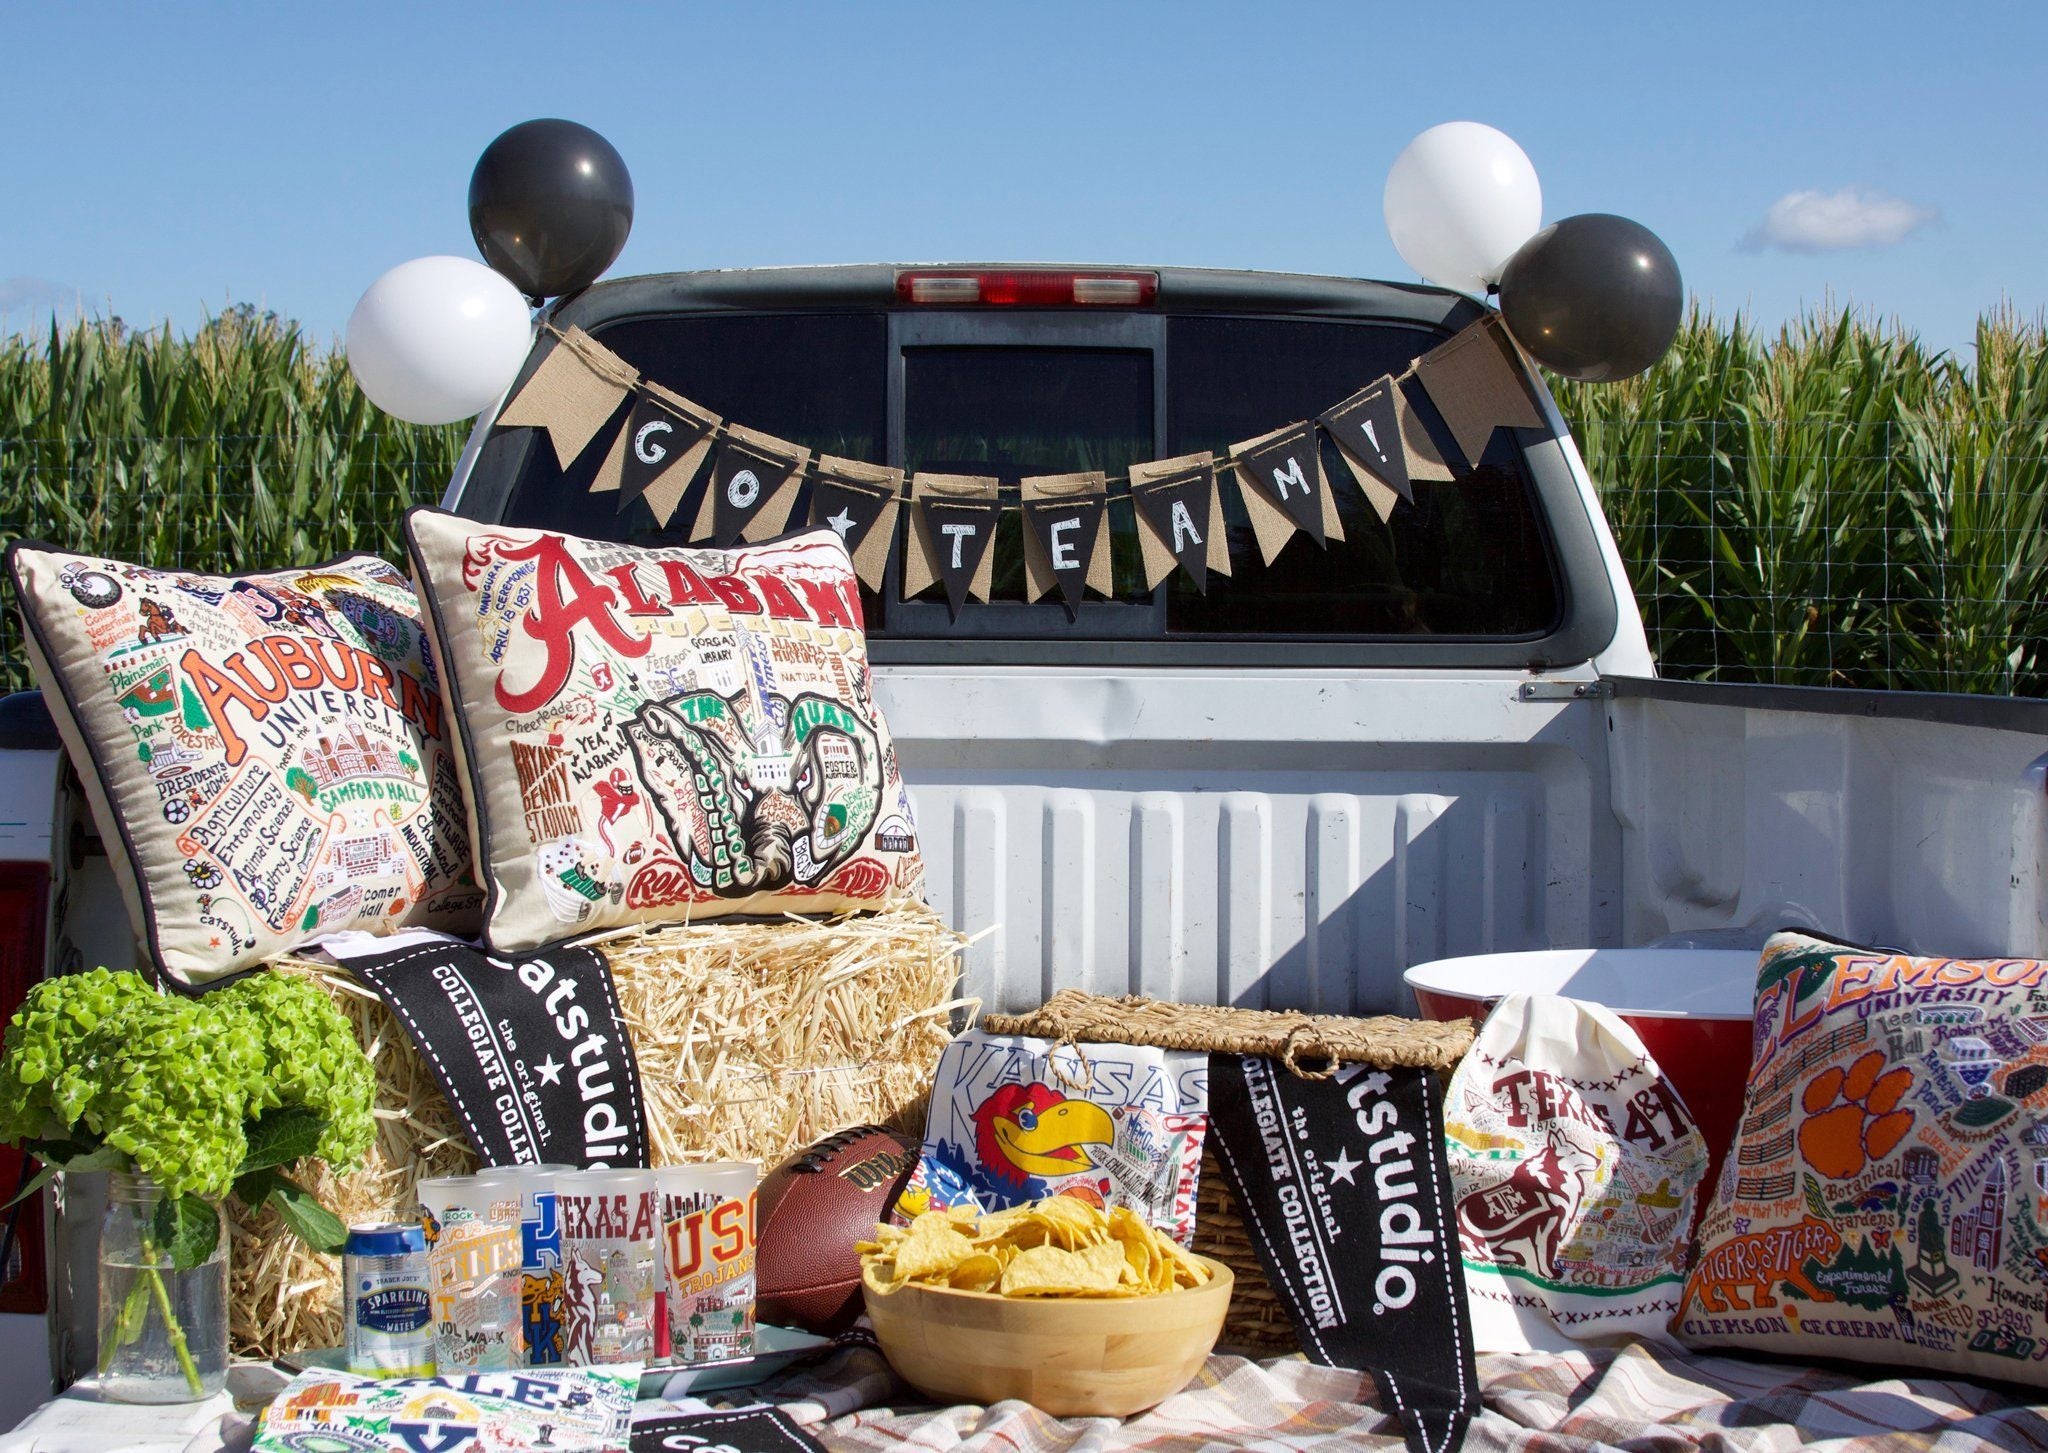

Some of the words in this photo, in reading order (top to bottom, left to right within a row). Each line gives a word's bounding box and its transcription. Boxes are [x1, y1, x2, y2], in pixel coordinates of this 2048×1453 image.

[634, 420, 760, 509] GO
[495, 560, 536, 612] CEREMONIES
[92, 626, 139, 652] Medicine
[192, 611, 239, 637] Auburn
[214, 629, 238, 648] love
[489, 628, 510, 664] APRIL
[500, 610, 517, 624] 18
[514, 583, 535, 609] 1831
[691, 634, 737, 650] GORGAS
[699, 649, 734, 664] LIBRARY
[770, 637, 826, 656] ALABAMA
[780, 671, 833, 684] NATURAL
[180, 634, 443, 768] AUBURN
[506, 699, 589, 735] Cheerleaders
[131, 718, 166, 742] Park
[165, 712, 225, 751] FORESTRY
[260, 690, 431, 750] UNIVERSITY
[321, 714, 339, 726] sun
[364, 719, 393, 739] kissed
[680, 697, 726, 724] THE
[792, 700, 856, 743] QUAD
[155, 760, 228, 801] PRESIDENT'S
[824, 760, 858, 773] FOSTER
[200, 772, 231, 801] HOME
[318, 780, 385, 814] SAMFORD
[388, 780, 423, 804] HALL
[522, 761, 571, 812] DENNY
[190, 764, 266, 846] Agriculture
[216, 782, 283, 868] Entomology
[280, 816, 313, 862] Science
[524, 805, 583, 844] STADIUM
[233, 835, 269, 893] Animal
[259, 797, 296, 846] Sciences
[401, 824, 440, 890] INDUSTRIAL
[416, 813, 460, 879] Chemical
[631, 868, 691, 901] ROLL
[357, 902, 384, 920] Hall
[200, 914, 244, 957] catstudio
[1856, 987, 2014, 1019] UNIVERSITY
[432, 965, 508, 1091] COLLEGIATE
[1876, 1012, 1913, 1035] Lee
[1931, 1025, 1987, 1047] Robert
[1886, 1030, 1923, 1064] Hall
[498, 1017, 517, 1052] the
[514, 1058, 552, 1148] original.
[923, 1040, 1210, 1149] KANSAS
[1912, 1078, 1953, 1116] Pond
[1492, 1068, 1620, 1137] TEXAS
[1530, 1119, 1557, 1133] 1876
[1291, 1105, 1310, 1140] the
[1303, 1149, 1343, 1245] original.
[1823, 1157, 1902, 1202] Botanical
[1947, 1132, 2010, 1204] TILLMAN
[2005, 1147, 2022, 1193] HALL
[1241, 1053, 1293, 1182] OLLEGIATE
[1277, 1184, 1338, 1331] COLLECTION
[1911, 1185, 1944, 1213] GREEN
[445, 1211, 474, 1221] ROCK
[1833, 1209, 1896, 1234] Gardens
[1696, 1240, 1762, 1285] TIGERS
[1756, 1234, 1779, 1285] FOR
[1776, 1225, 1835, 1272] TIGERS
[679, 1253, 755, 1298] TROJANS
[1571, 1264, 1664, 1287] COLLEGE
[367, 1290, 428, 1309] SPARKLING
[437, 1296, 456, 1322] T
[1931, 1303, 1974, 1328] FIELD
[386, 1321, 416, 1333] WATER
[438, 1321, 462, 1337] VOL
[465, 1329, 505, 1345] WALK
[1684, 1317, 1790, 1336] CLEMSON
[1825, 1319, 1901, 1341] CREAM
[1916, 1319, 1958, 1343] ARMY
[1977, 1307, 2033, 1335] Riggs
[311, 1421, 349, 1433] YALE
[352, 1427, 392, 1449] BOWL
